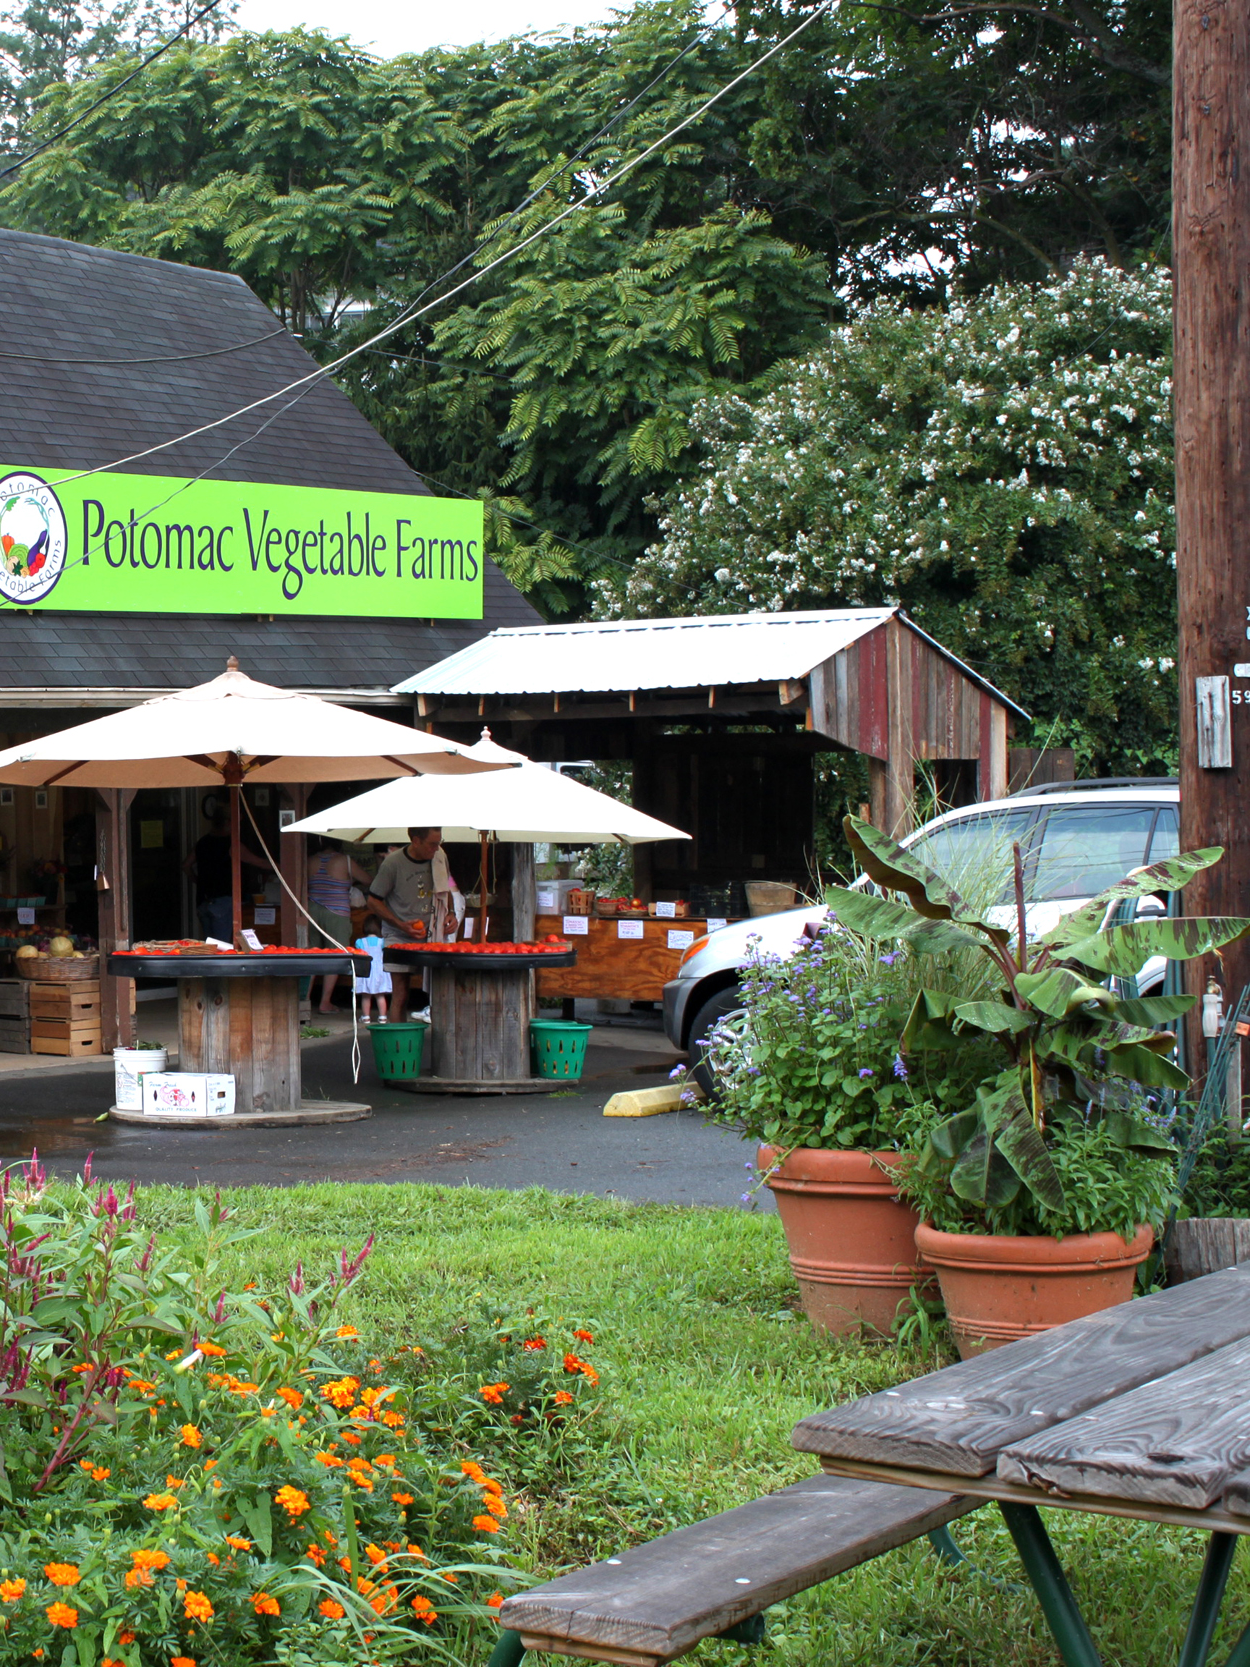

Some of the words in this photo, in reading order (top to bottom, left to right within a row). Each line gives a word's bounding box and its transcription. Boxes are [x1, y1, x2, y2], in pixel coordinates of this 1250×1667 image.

[81, 499, 234, 573] Potomac
[242, 507, 387, 601] Vegetable
[395, 519, 479, 582] Farms
